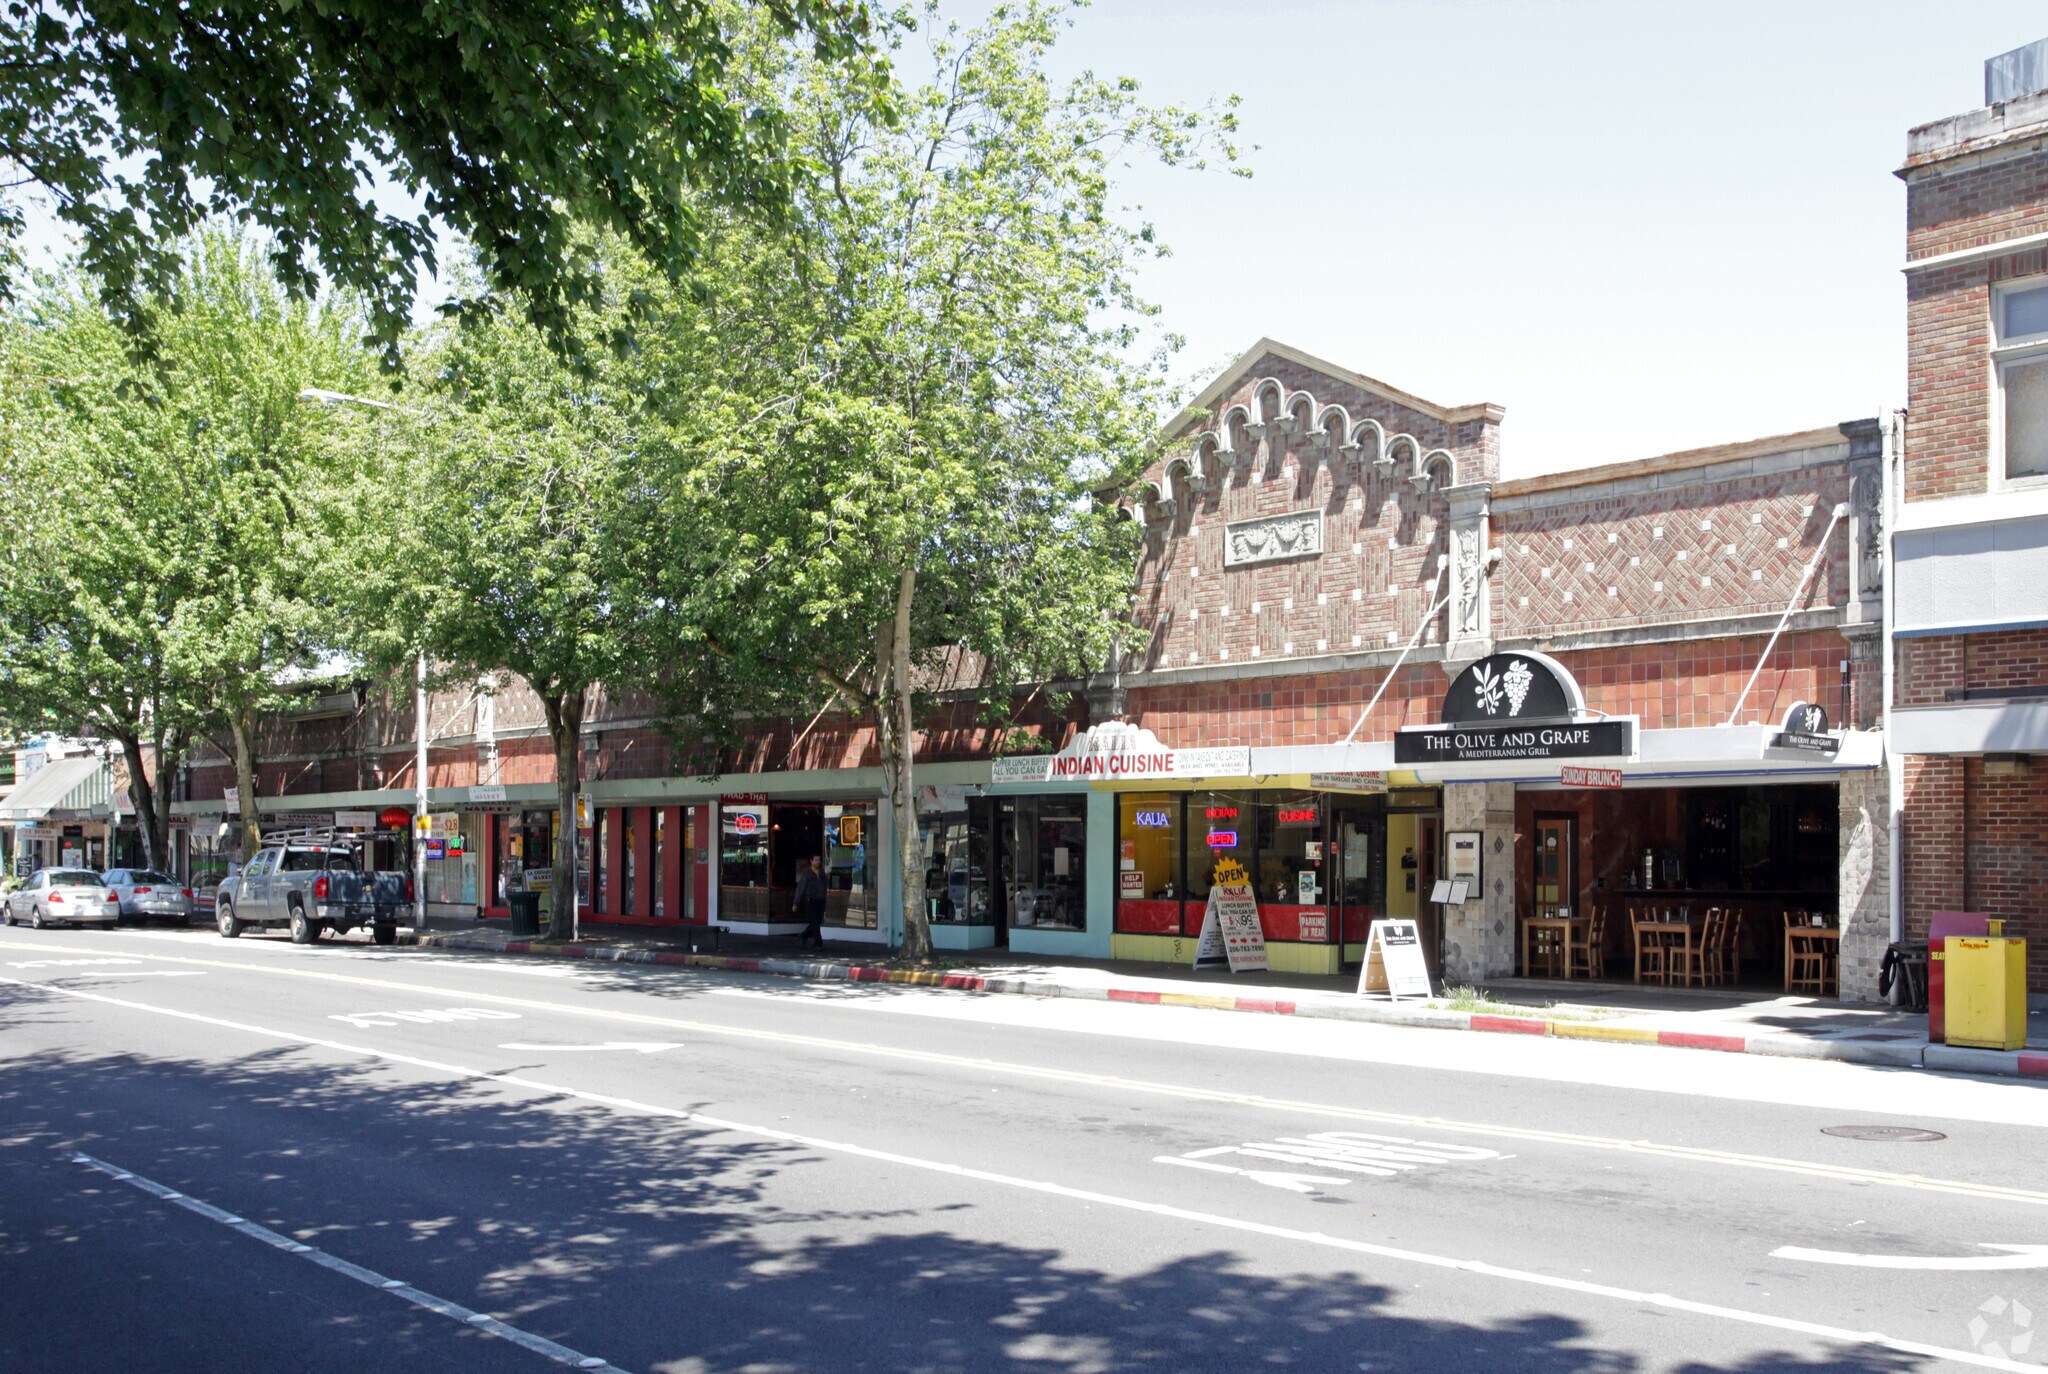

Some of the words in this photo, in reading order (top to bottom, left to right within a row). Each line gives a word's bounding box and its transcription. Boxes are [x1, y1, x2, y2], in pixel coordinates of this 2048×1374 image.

[1424, 735, 1451, 750] THE
[1455, 734, 1496, 749] OLIVE
[1502, 733, 1535, 747] AND
[1540, 730, 1590, 745] GRAPE
[1797, 736, 1809, 744] OLIVE
[1819, 738, 1832, 747] GRAPE
[1458, 750, 1465, 758] A
[1465, 748, 1526, 758] MEDITERRANEAN
[1527, 747, 1550, 756] GRILL
[1012, 757, 1030, 767] LUNCH
[1030, 756, 1048, 766] BUFFET
[1052, 756, 1104, 775] INDIAN
[1109, 753, 1174, 774] CUISINE
[993, 767, 1004, 776] ALL
[1006, 766, 1019, 775] YOU
[1020, 766, 1035, 775] CAN
[1036, 765, 1048, 774] EAT
[1562, 767, 1587, 784] SUNDAY
[1587, 771, 1622, 786] BRUNCH
[723, 792, 744, 800] PHAD
[749, 792, 767, 801] THAI
[1206, 807, 1238, 819] INDIAN
[1278, 808, 1316, 823] CUISINE
[735, 816, 755, 832] OPEN
[1206, 834, 1235, 846] OPEN
[1218, 867, 1244, 884] OPEN
[1223, 887, 1247, 897] KALIA
[1301, 916, 1326, 927] PARKING
[1302, 928, 1309, 937] IN
[1311, 927, 1325, 936] REAR
[1152, 1131, 1500, 1192] ONLY
